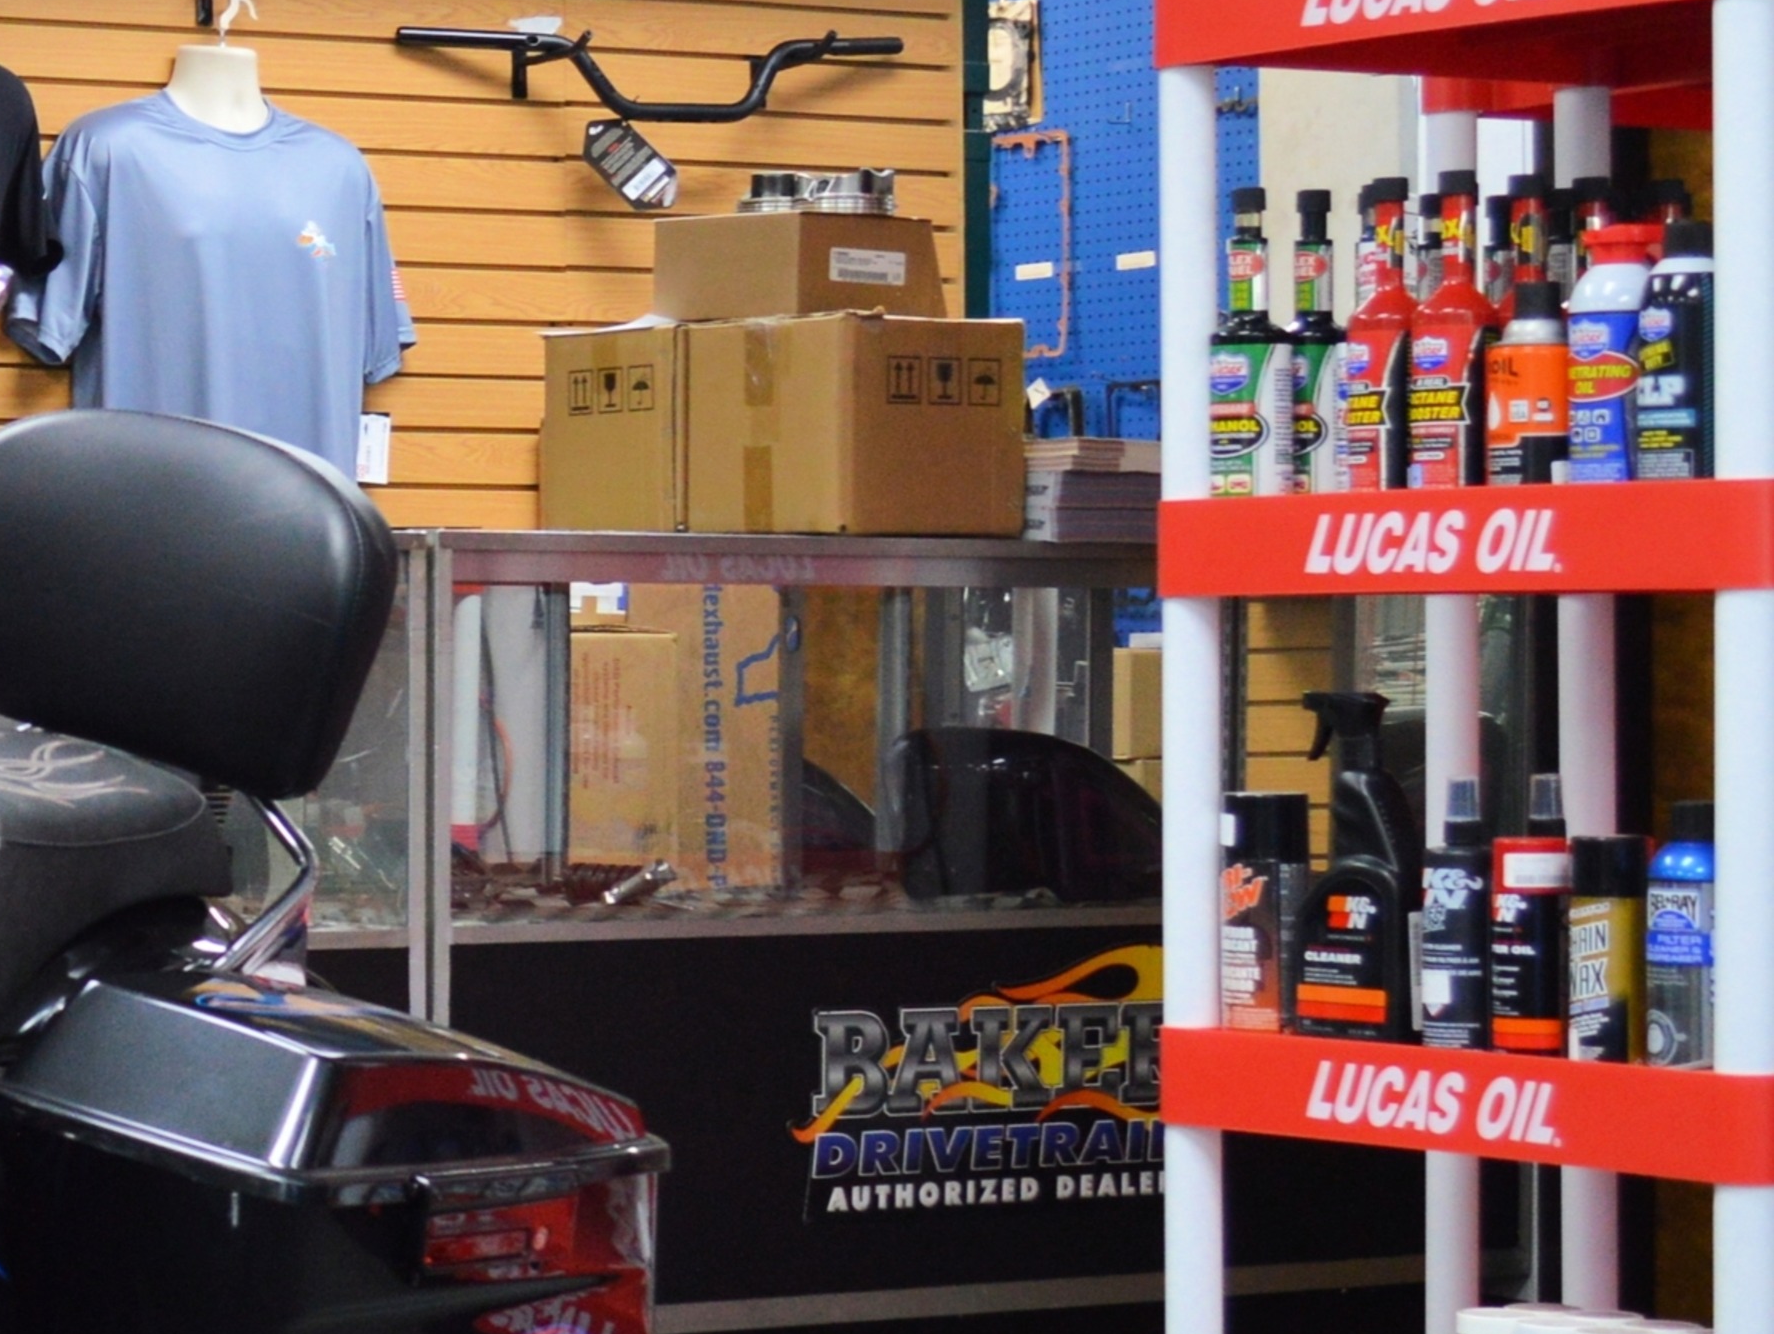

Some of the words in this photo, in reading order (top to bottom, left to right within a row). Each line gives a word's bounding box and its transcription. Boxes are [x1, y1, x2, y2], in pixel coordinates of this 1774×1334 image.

[1229, 254, 1253, 267] LEX
[1295, 254, 1316, 267] LEX
[1229, 265, 1254, 277] UEL
[1295, 265, 1316, 277] UEL
[1569, 364, 1632, 380] ETRATING
[1574, 381, 1597, 395] OIL
[1348, 395, 1380, 409] TANE
[1410, 390, 1459, 405] CTANE
[1347, 410, 1382, 425] STER
[1410, 405, 1462, 421] OOSTER
[1211, 420, 1261, 433] HANOL
[1304, 511, 1465, 576] LUCAS
[1475, 508, 1556, 575] OIL
[702, 584, 725, 753] exhaust.com
[1570, 921, 1610, 958] HAIN
[1304, 950, 1363, 966] CLEANER
[1570, 958, 1608, 1000] AX
[1306, 1060, 1466, 1135] LUCAS
[1476, 1075, 1556, 1146] OIL
[826, 1176, 1041, 1213] AUTHORIZED
